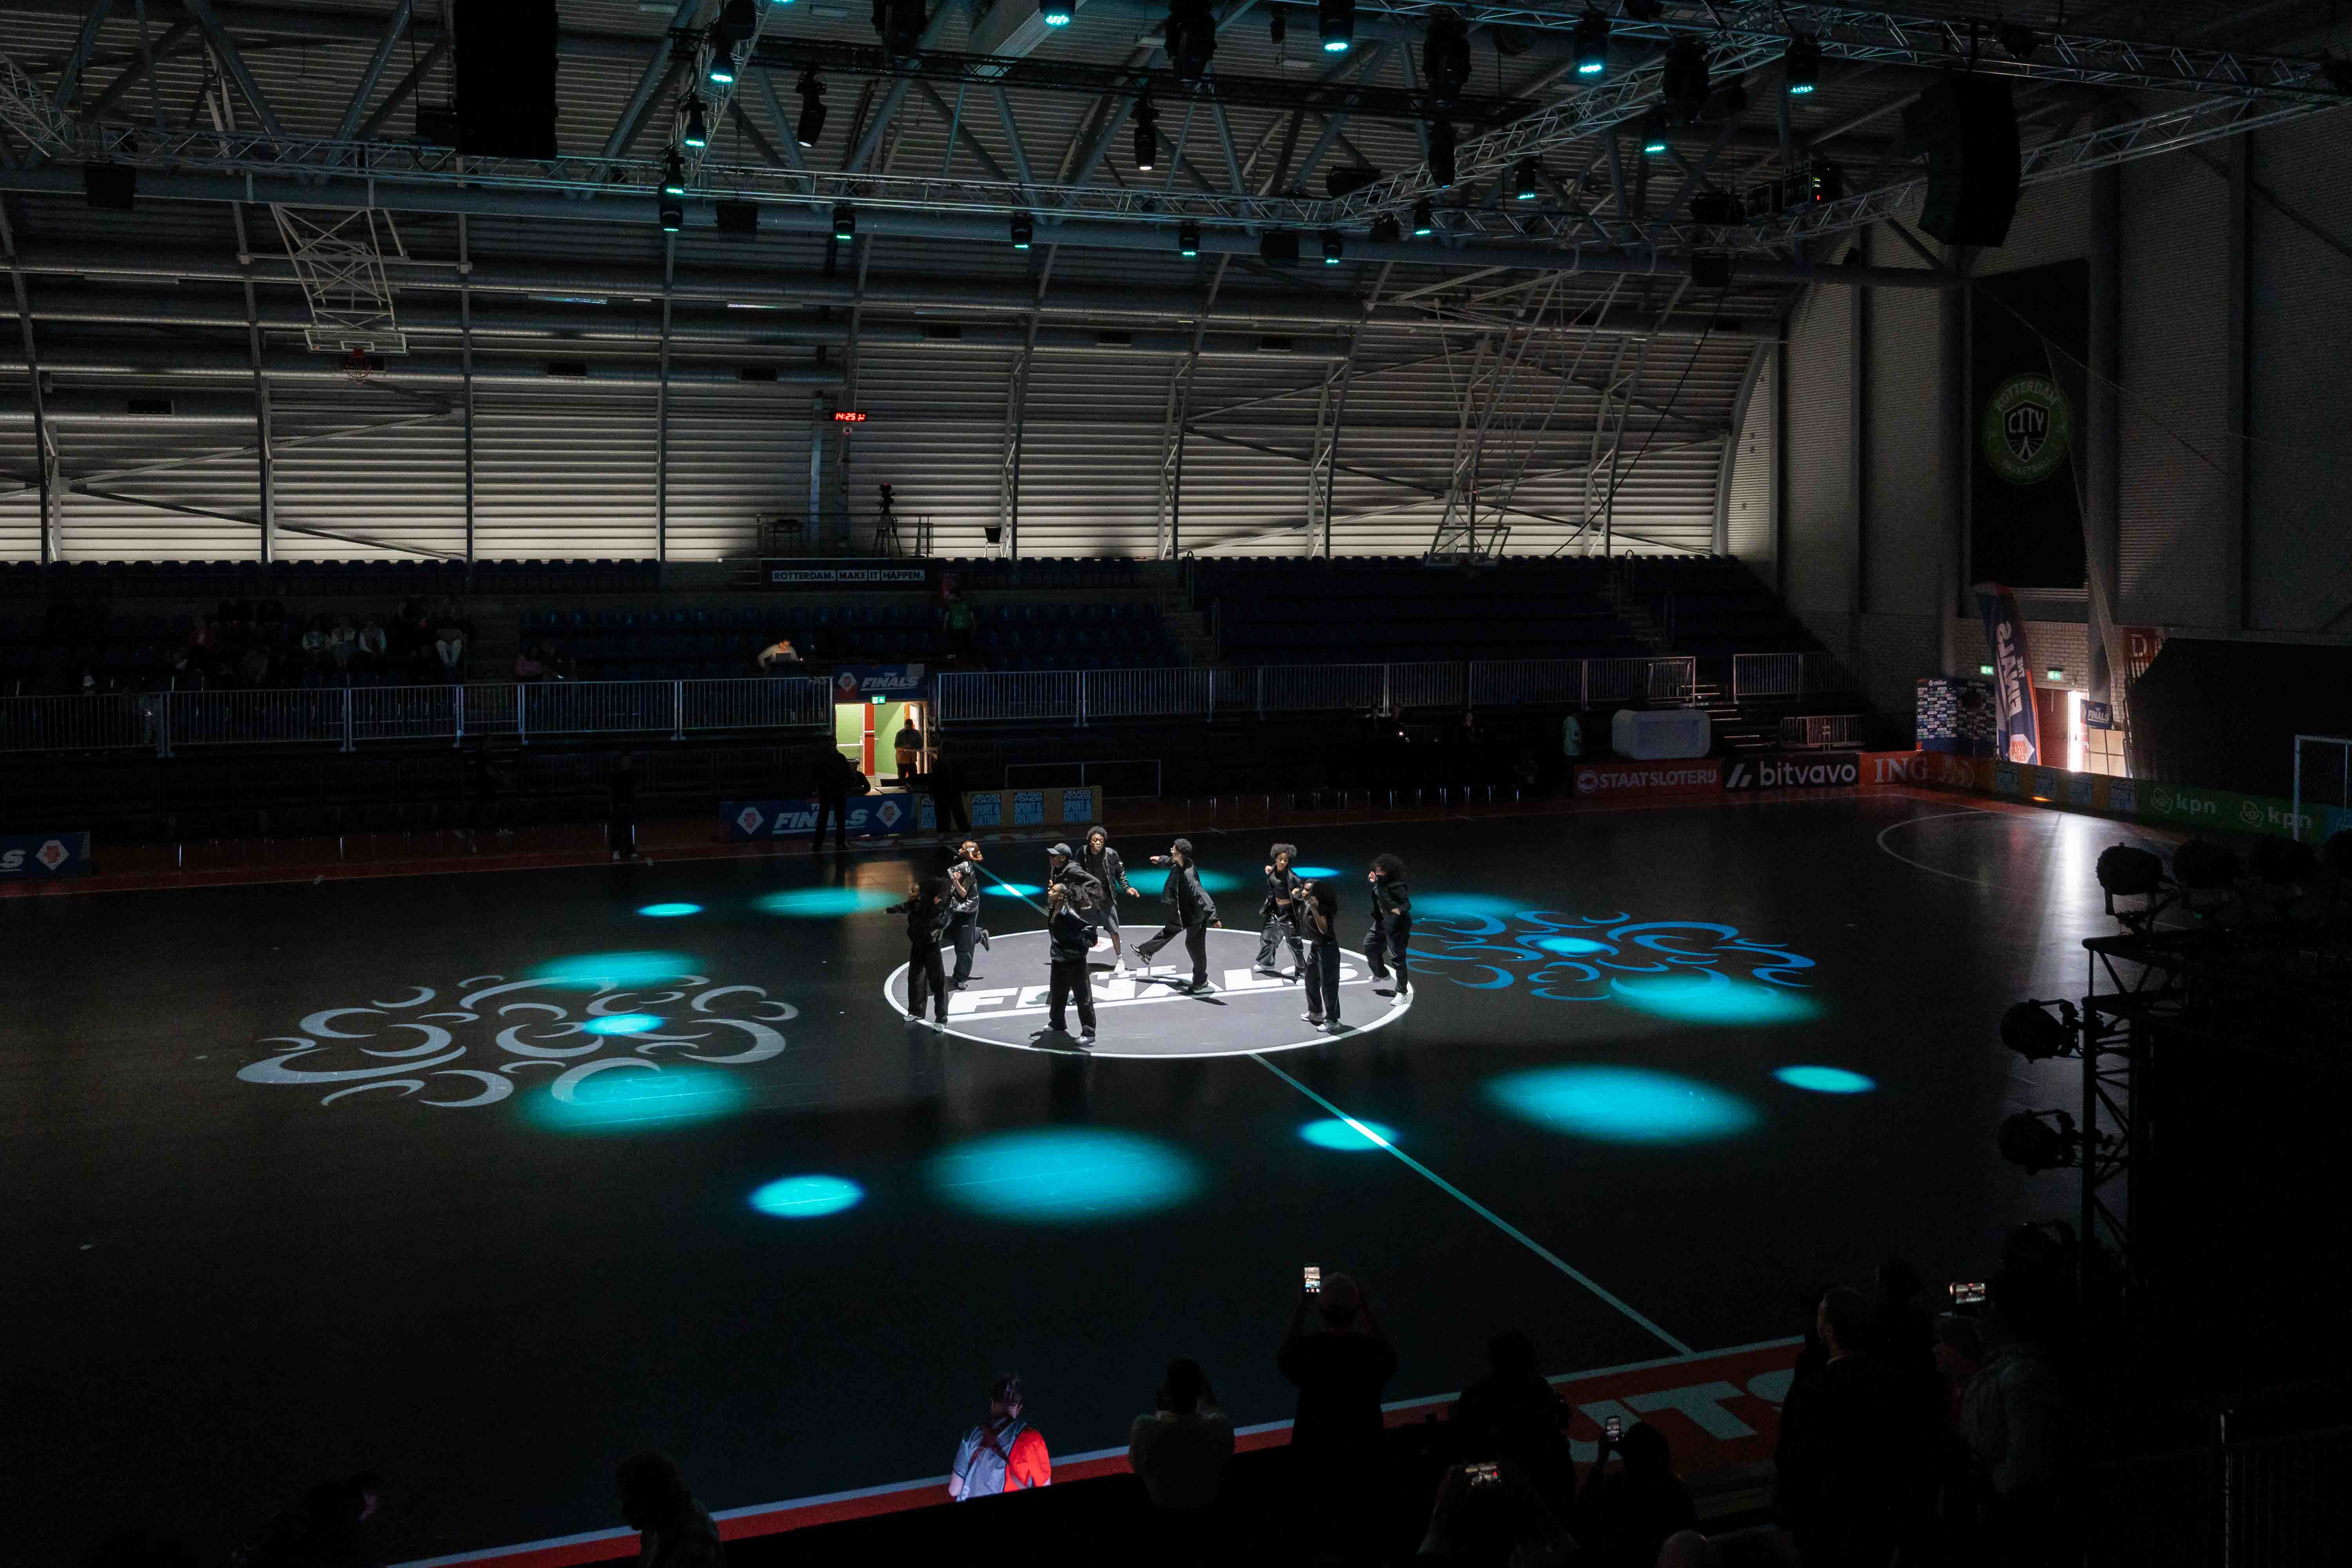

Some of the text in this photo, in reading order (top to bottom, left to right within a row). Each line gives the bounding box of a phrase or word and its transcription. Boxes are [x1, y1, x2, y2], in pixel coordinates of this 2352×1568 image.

[2007, 407, 2043, 433] CITY
[882, 571, 924, 579] HAPPEN.
[861, 677, 919, 688] FINALS
[1759, 760, 1857, 786] bitvavo
[1874, 756, 1927, 783] ING
[2176, 793, 2216, 815] kpn
